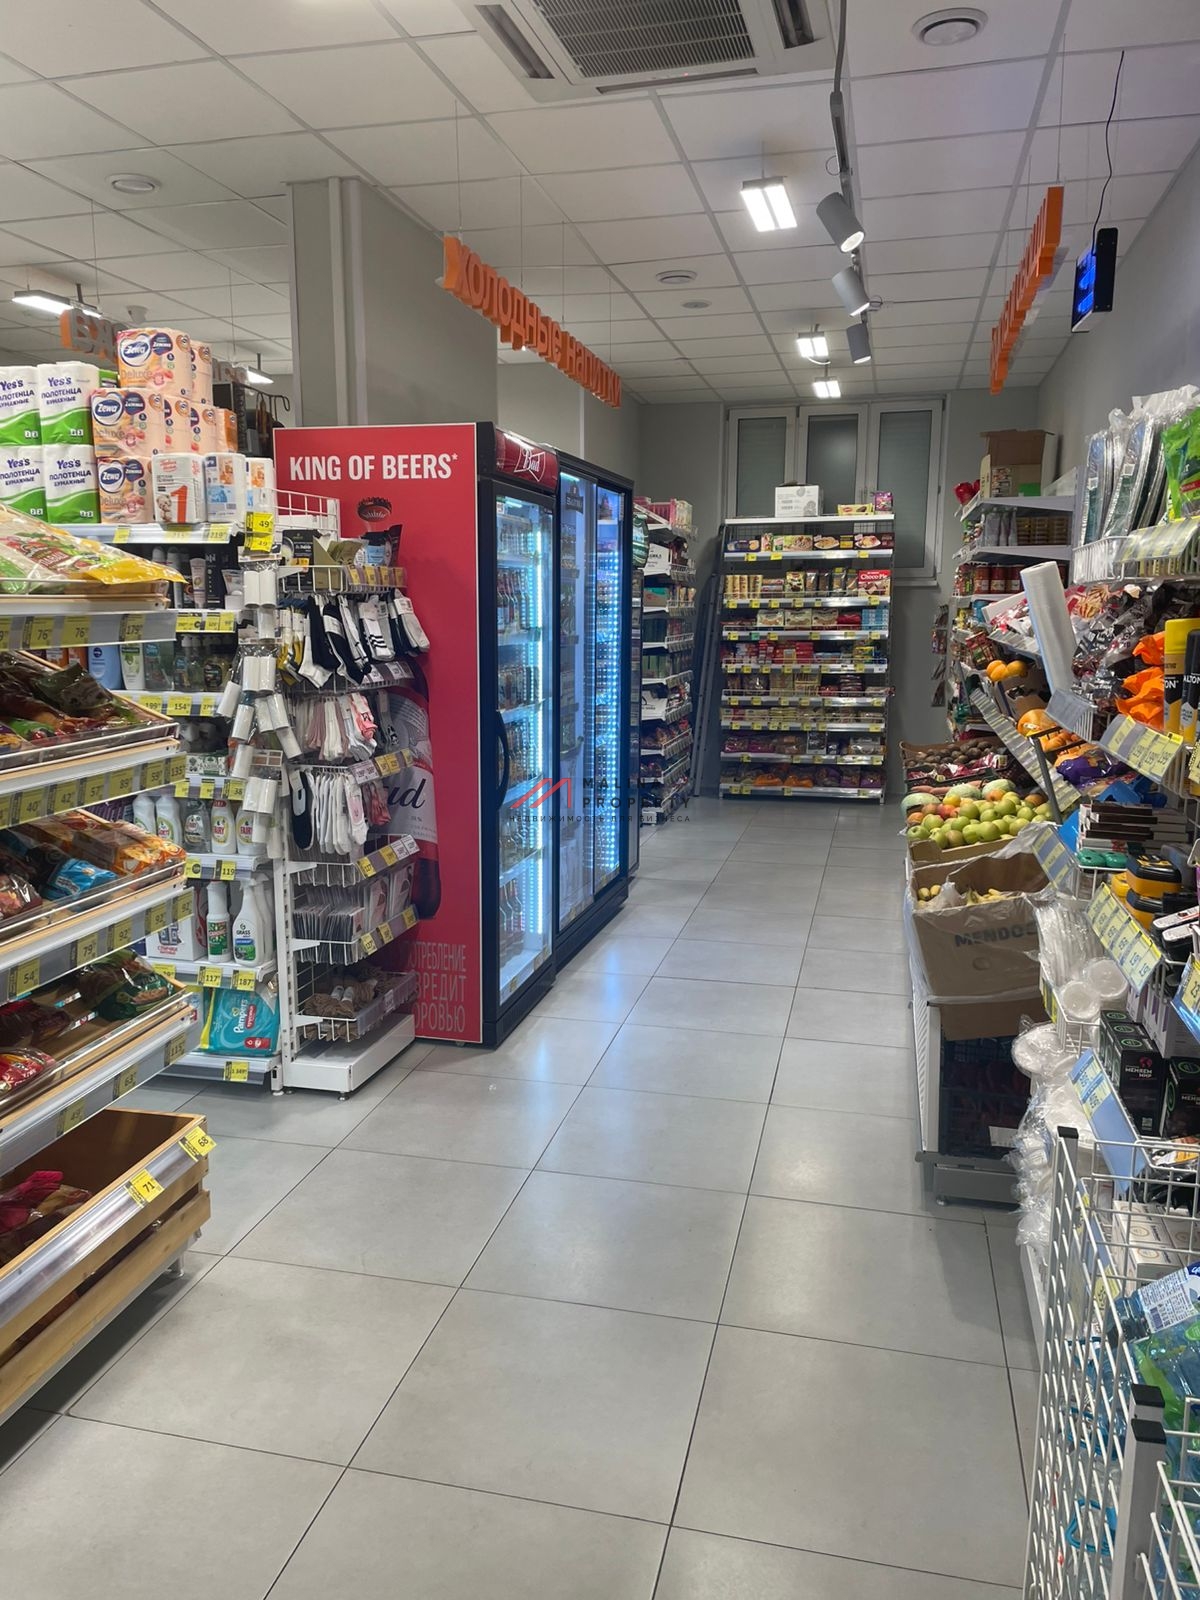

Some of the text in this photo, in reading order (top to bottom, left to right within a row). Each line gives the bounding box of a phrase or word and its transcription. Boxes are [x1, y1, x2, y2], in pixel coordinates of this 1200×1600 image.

[0, 380, 24, 391] Yes's
[47, 376, 72, 388] Yes's
[41, 387, 82, 399] ПОЛОТЕНЦА
[97, 403, 117, 413] Zewa
[7, 458, 30, 469] Yes's
[57, 459, 81, 470] Yes's
[290, 456, 341, 481] KING
[348, 455, 375, 480] OF
[0, 468, 41, 480] ПОЛОТЕНЦА
[49, 470, 92, 481] ПОЛОТЕНЦА
[233, 999, 249, 1033] Pampers
